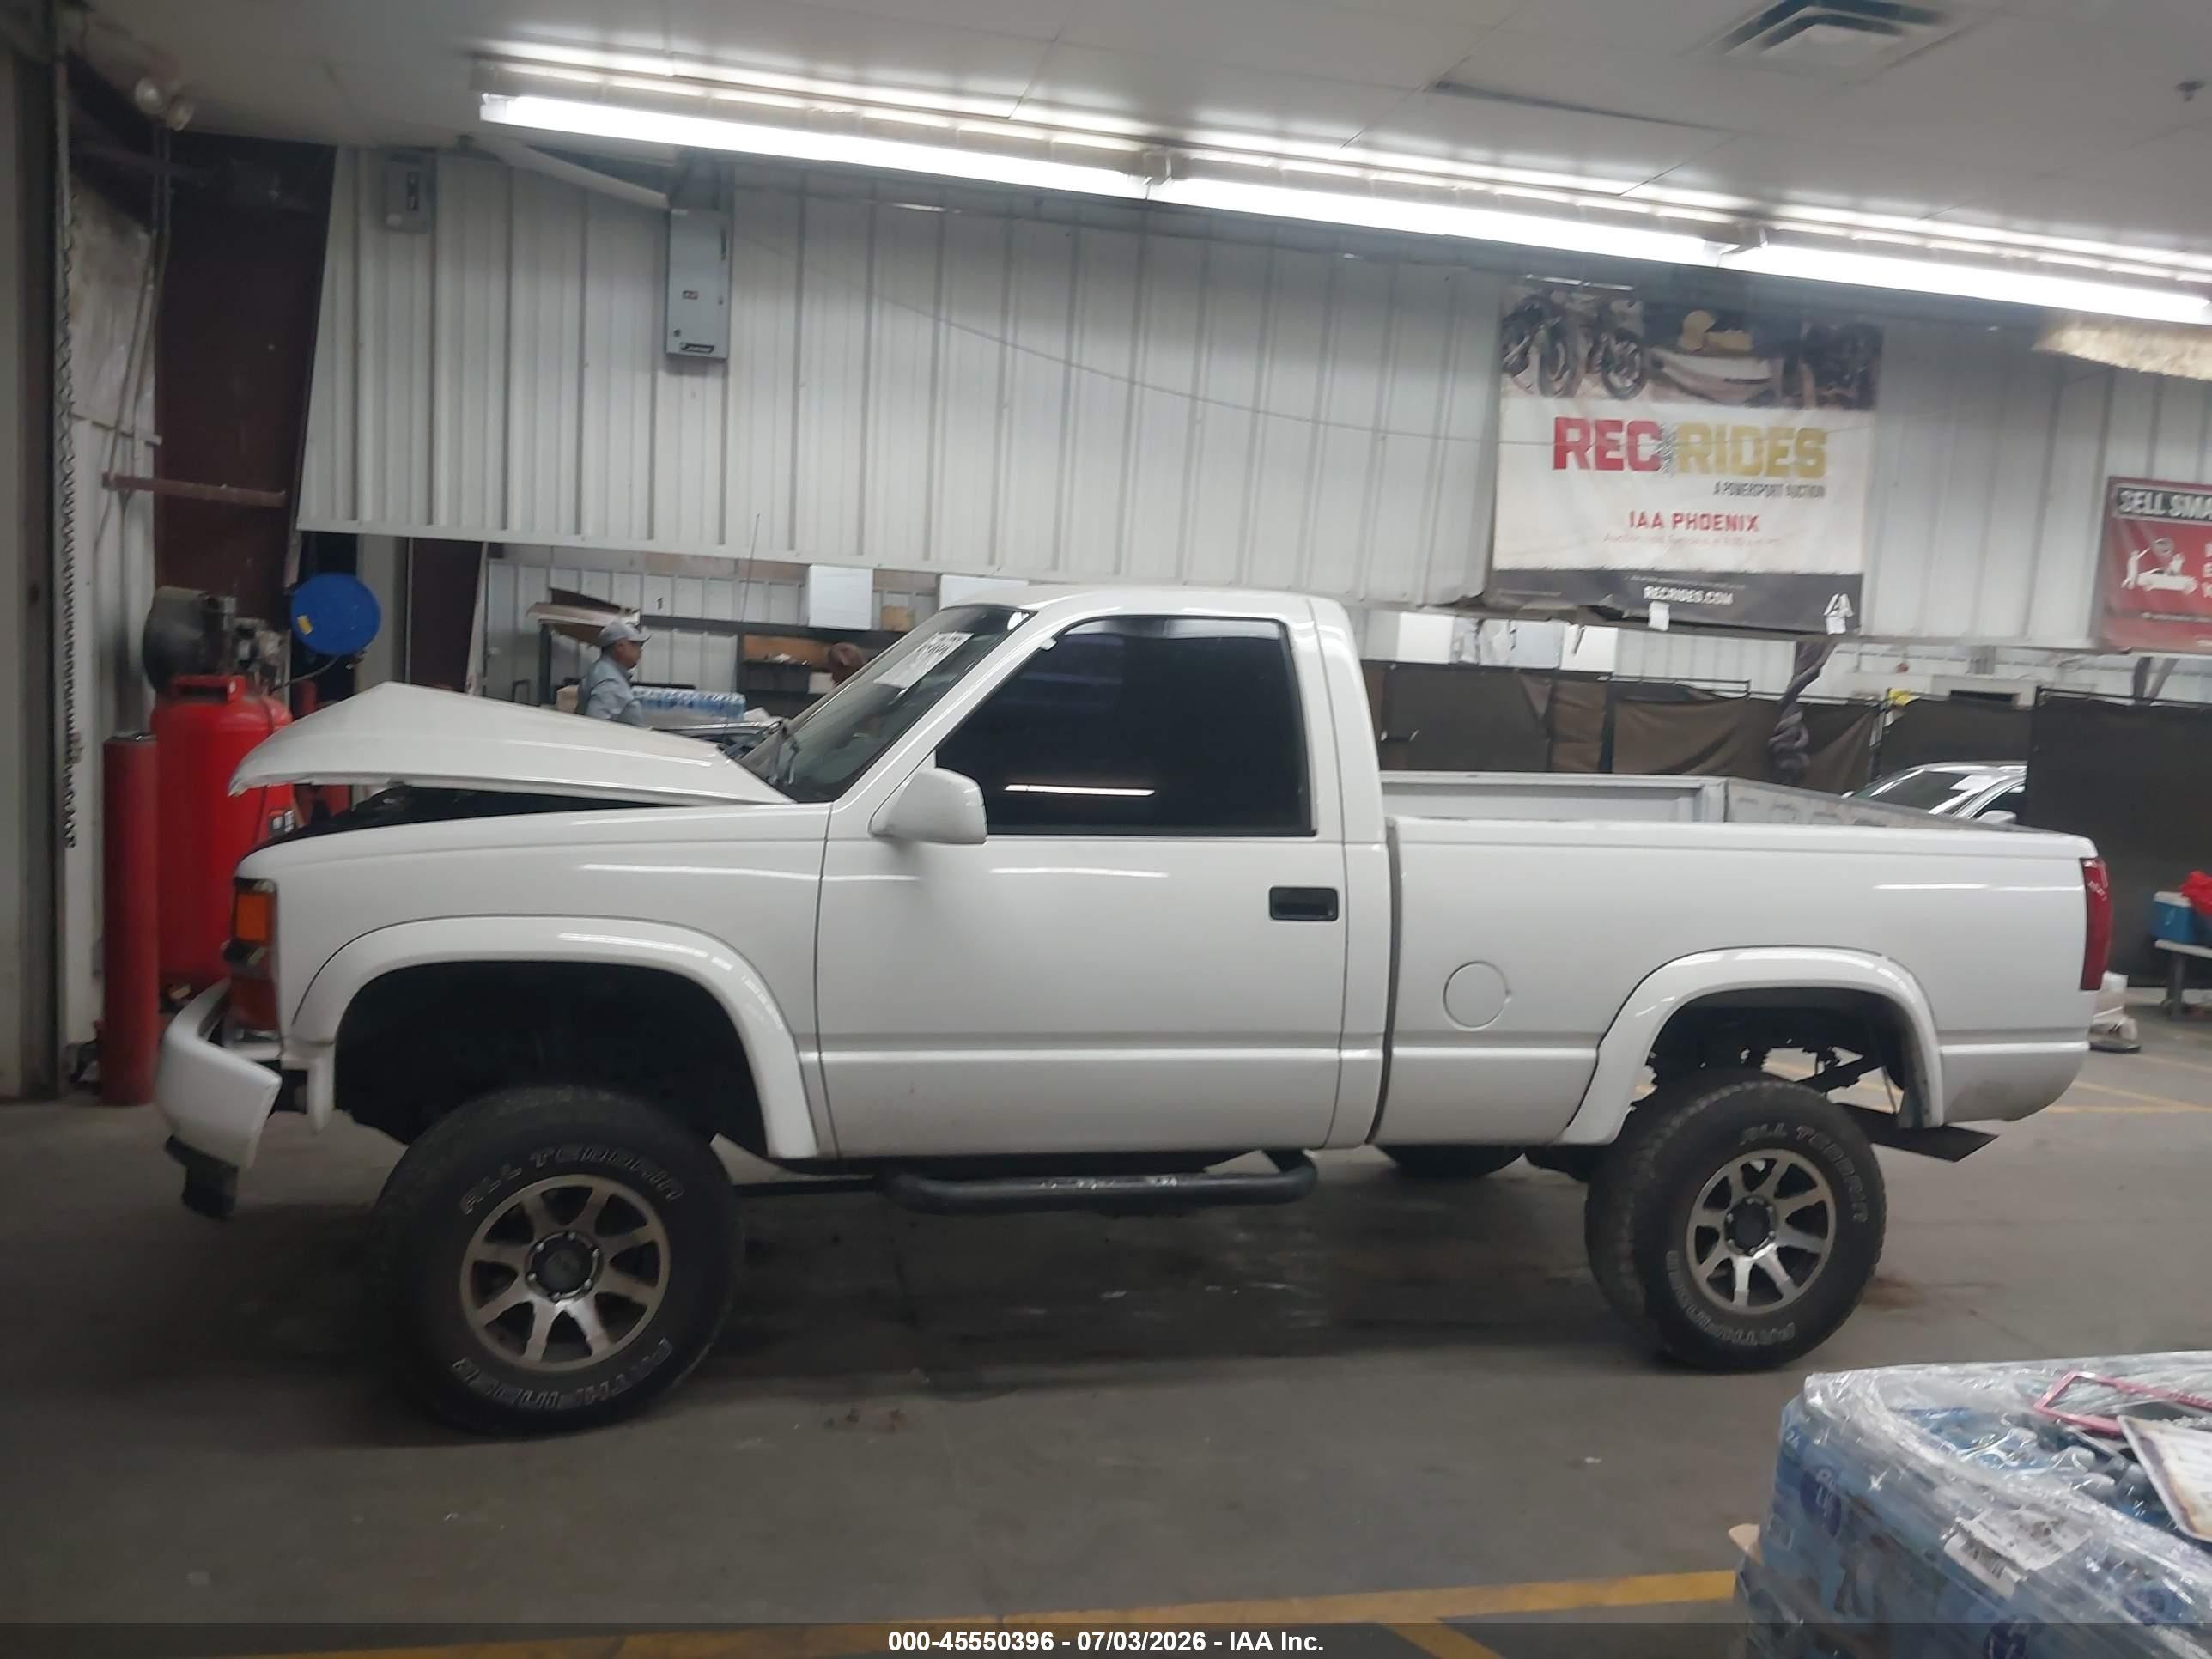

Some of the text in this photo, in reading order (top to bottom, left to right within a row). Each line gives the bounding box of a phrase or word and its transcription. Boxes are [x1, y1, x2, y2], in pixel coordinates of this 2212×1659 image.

[1553, 416, 1827, 479] REC RIDES
[2118, 489, 2166, 515] SELL
[1628, 509, 1760, 532] IAA PHOENIX
